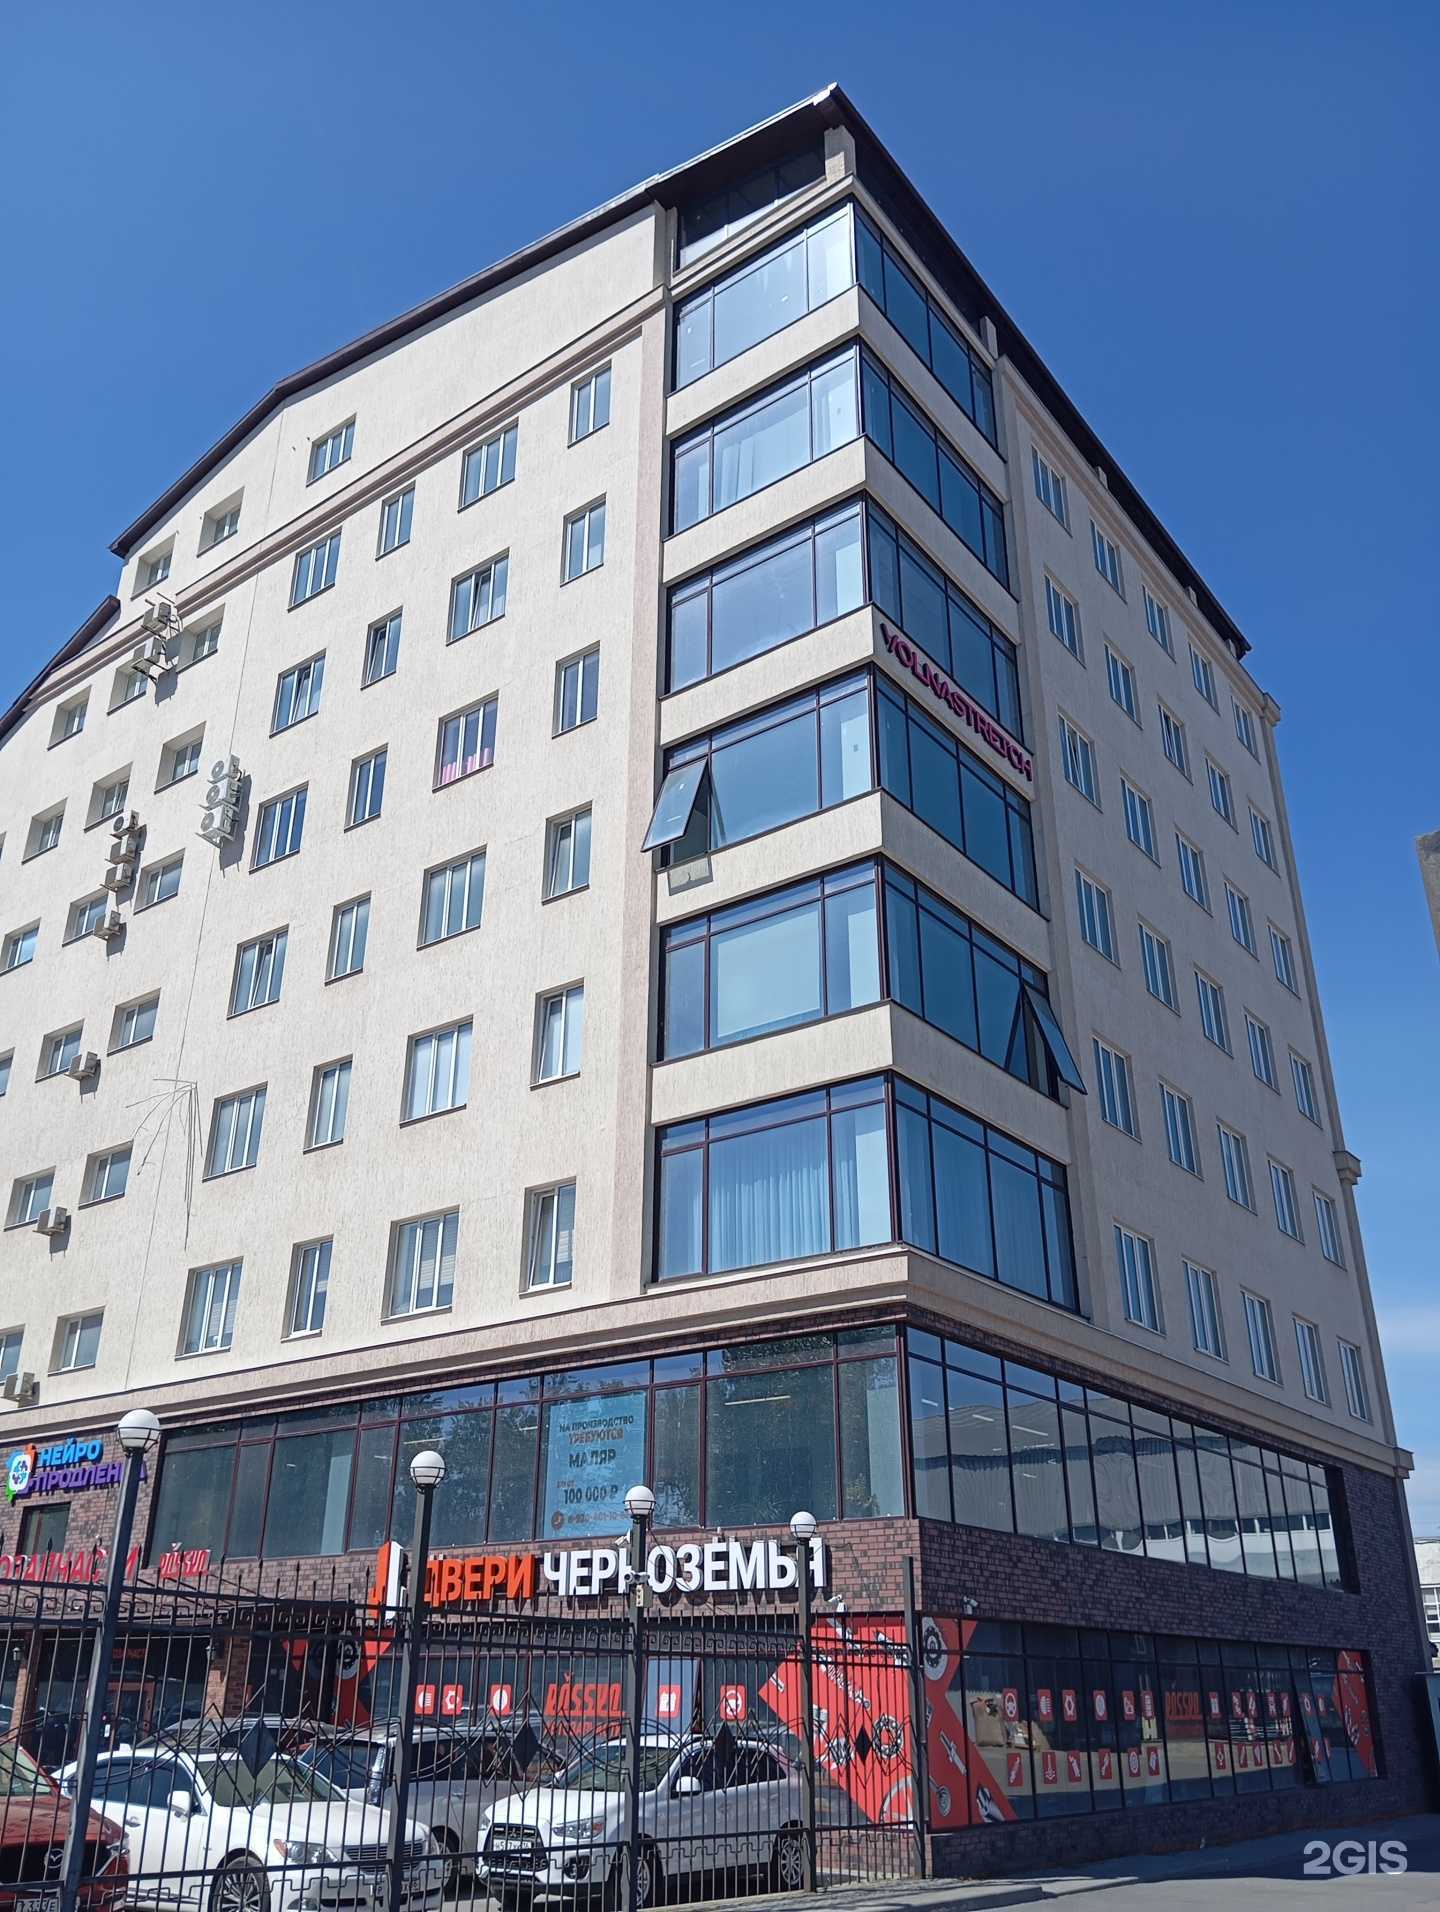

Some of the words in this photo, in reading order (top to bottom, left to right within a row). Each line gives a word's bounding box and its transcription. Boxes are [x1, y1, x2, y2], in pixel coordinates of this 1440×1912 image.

[880, 623, 1033, 781] VOLNASTRETCH
[38, 1436, 102, 1466] НЕЙРО
[569, 1449, 616, 1467] МАЛЯР
[38, 1461, 146, 1490] ПРОДЛЕН
[563, 1488, 582, 1504] 100
[585, 1486, 607, 1502] 000
[423, 1554, 535, 1607] ДВЕРИ
